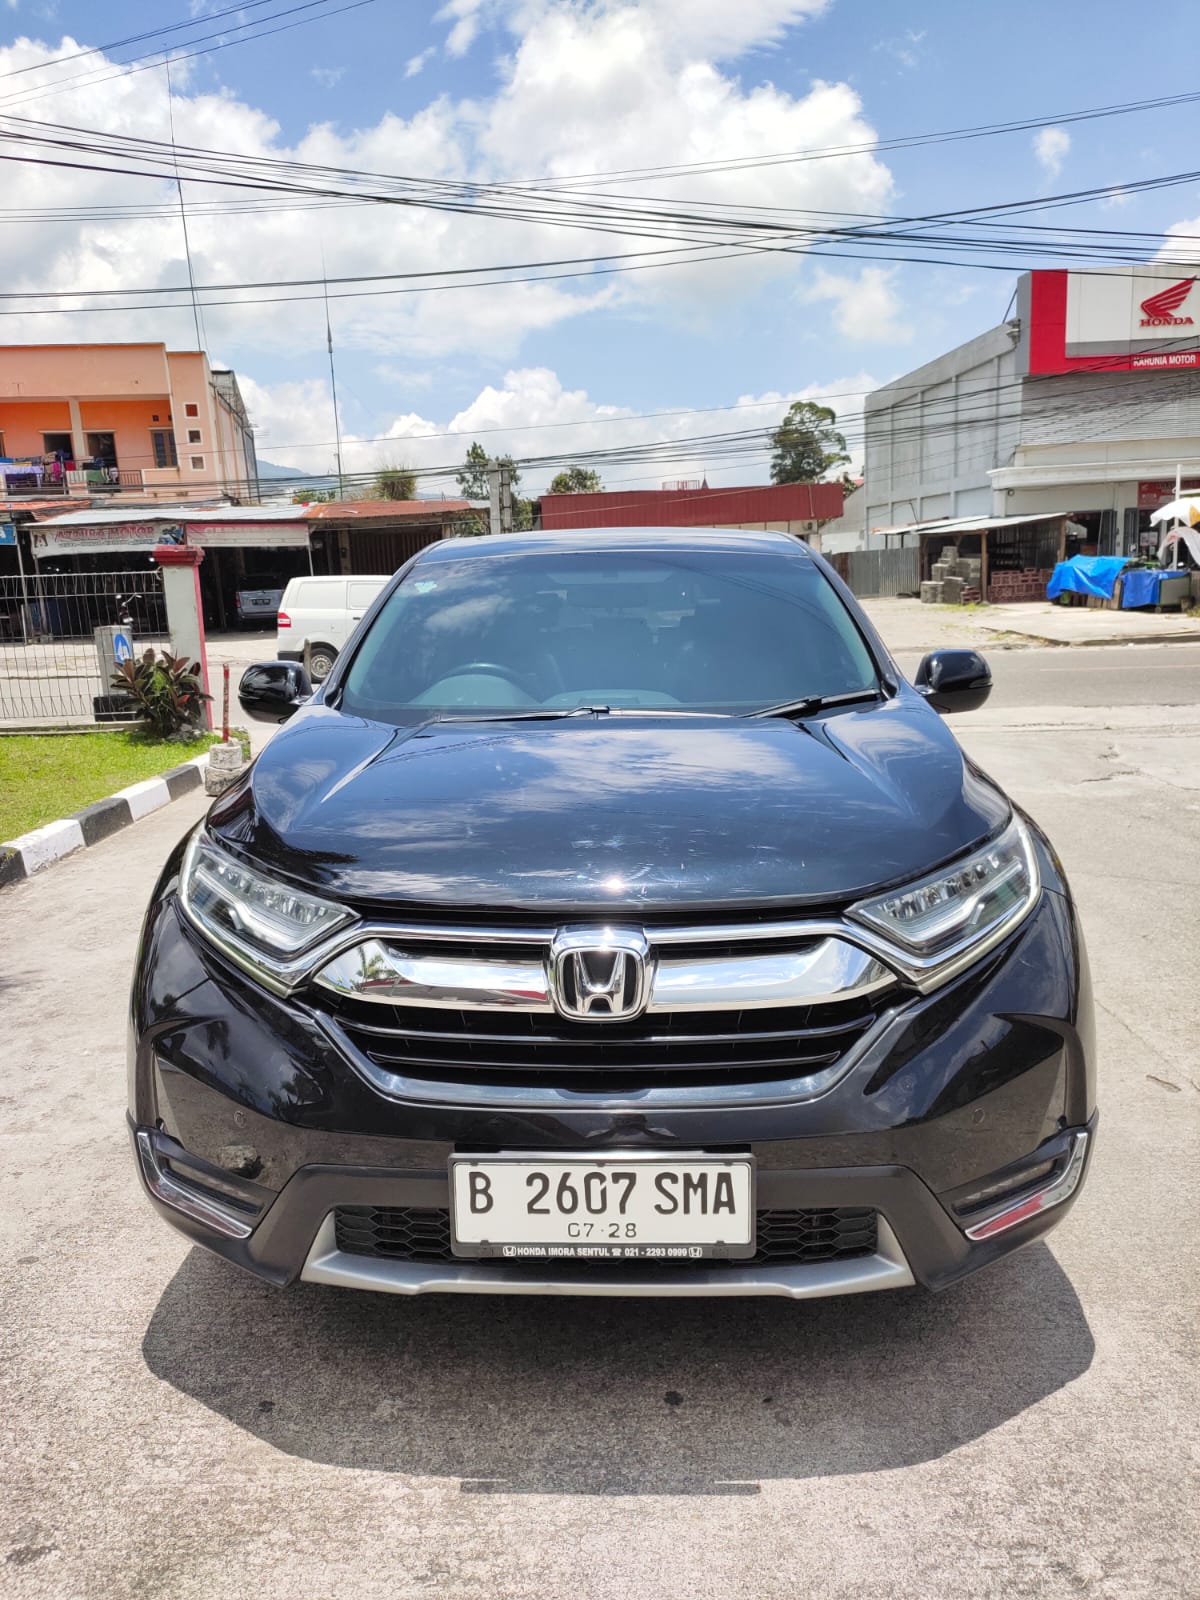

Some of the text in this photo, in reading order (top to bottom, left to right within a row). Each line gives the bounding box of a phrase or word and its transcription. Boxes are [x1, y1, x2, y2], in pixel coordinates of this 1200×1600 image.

[1140, 316, 1194, 327] HONDA
[1169, 354, 1196, 365] MOTOR
[468, 1171, 736, 1215] B 2607 SMA
[517, 1247, 546, 1256] HONDA
[548, 1247, 575, 1256] IMORA
[577, 1247, 610, 1257] SENTUL
[624, 1247, 639, 1257] 021
[646, 1247, 666, 1257] 2293
